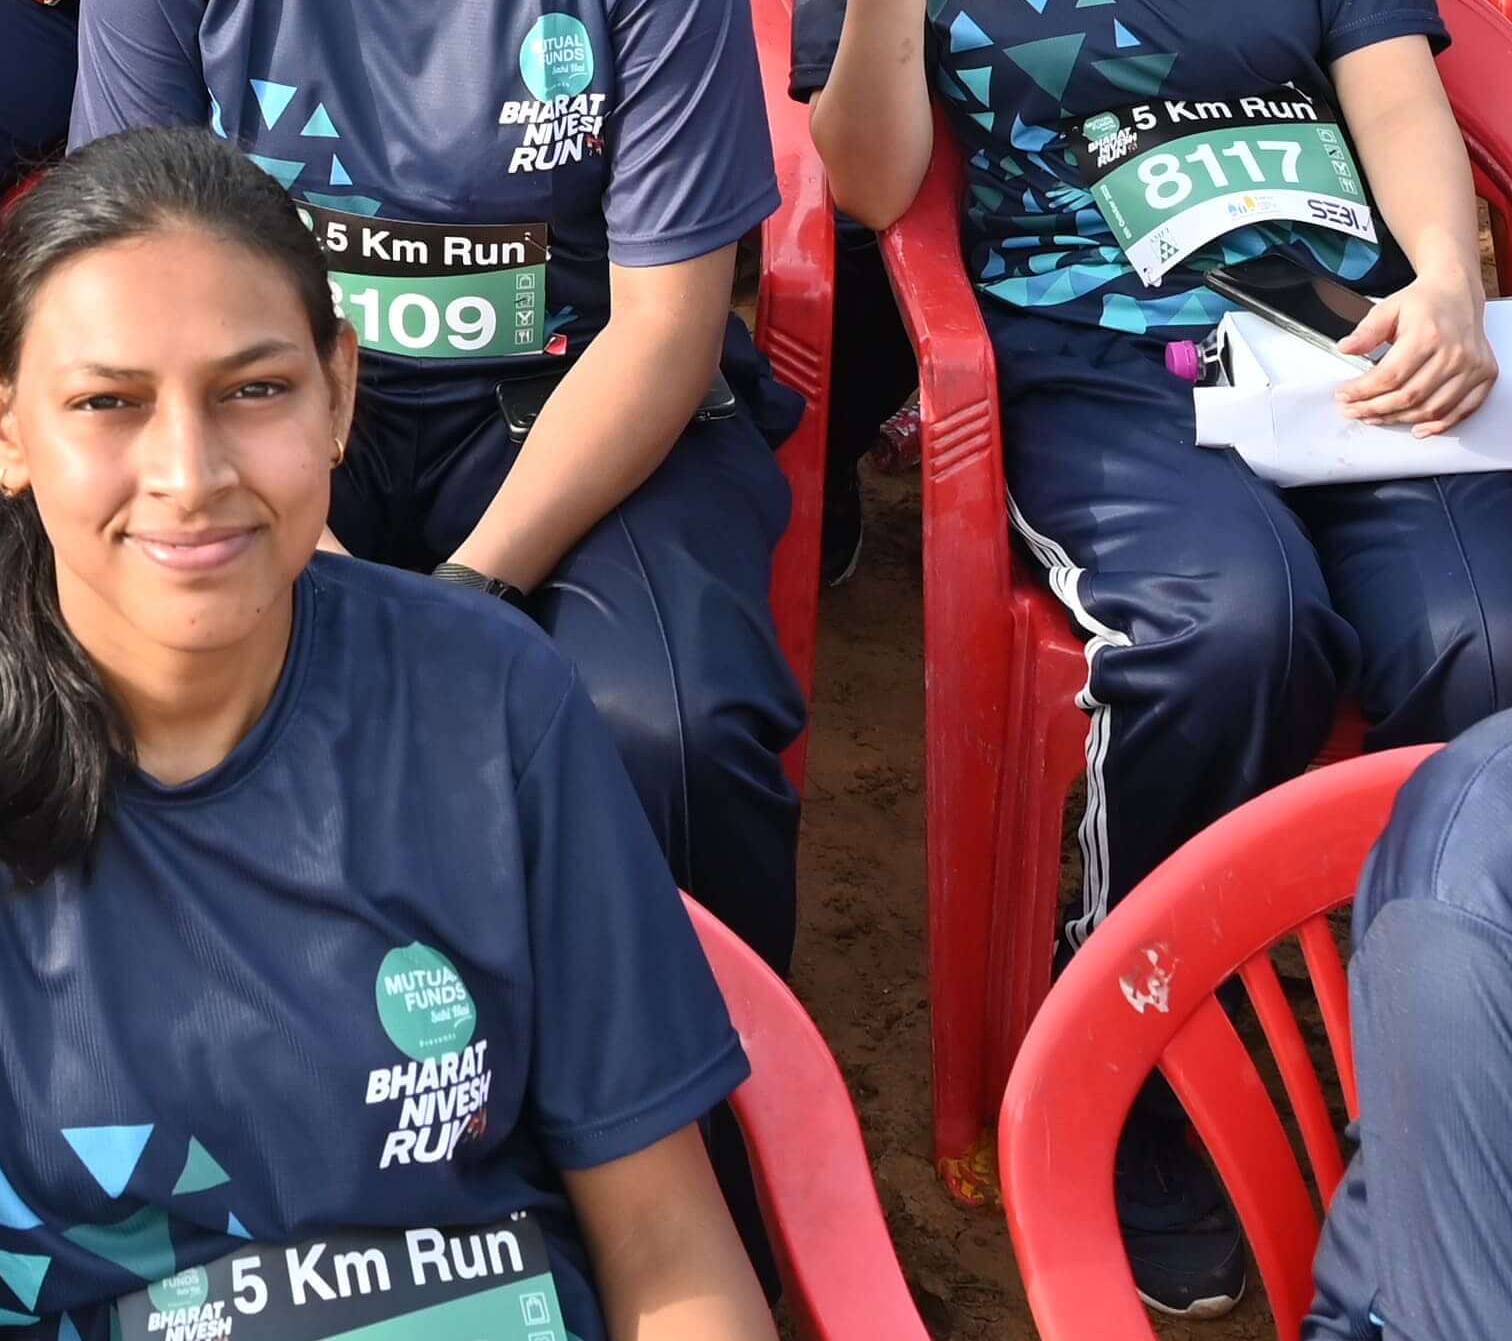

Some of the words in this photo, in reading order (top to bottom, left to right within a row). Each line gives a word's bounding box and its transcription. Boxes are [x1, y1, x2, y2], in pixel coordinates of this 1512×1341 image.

[538, 47, 585, 66] FUNDS
[499, 92, 607, 126] BHARAT
[1132, 104, 1158, 132] 5
[1164, 96, 1233, 126] Km
[1239, 94, 1318, 122] Run
[508, 137, 583, 175] RUN
[1136, 139, 1303, 211] 8117
[1307, 198, 1360, 231] SEBI
[326, 222, 348, 254] 5
[361, 230, 428, 265] Km
[444, 235, 525, 267] Run
[405, 982, 467, 1013] FUNDS
[364, 1039, 488, 1105] BHARAT
[398, 1068, 493, 1131] NIVESH
[162, 1274, 200, 1290] FUNDS
[231, 1256, 269, 1315] 5
[284, 1242, 391, 1308] Km
[405, 1227, 525, 1285] Run
[148, 1300, 225, 1332] BHARAT
